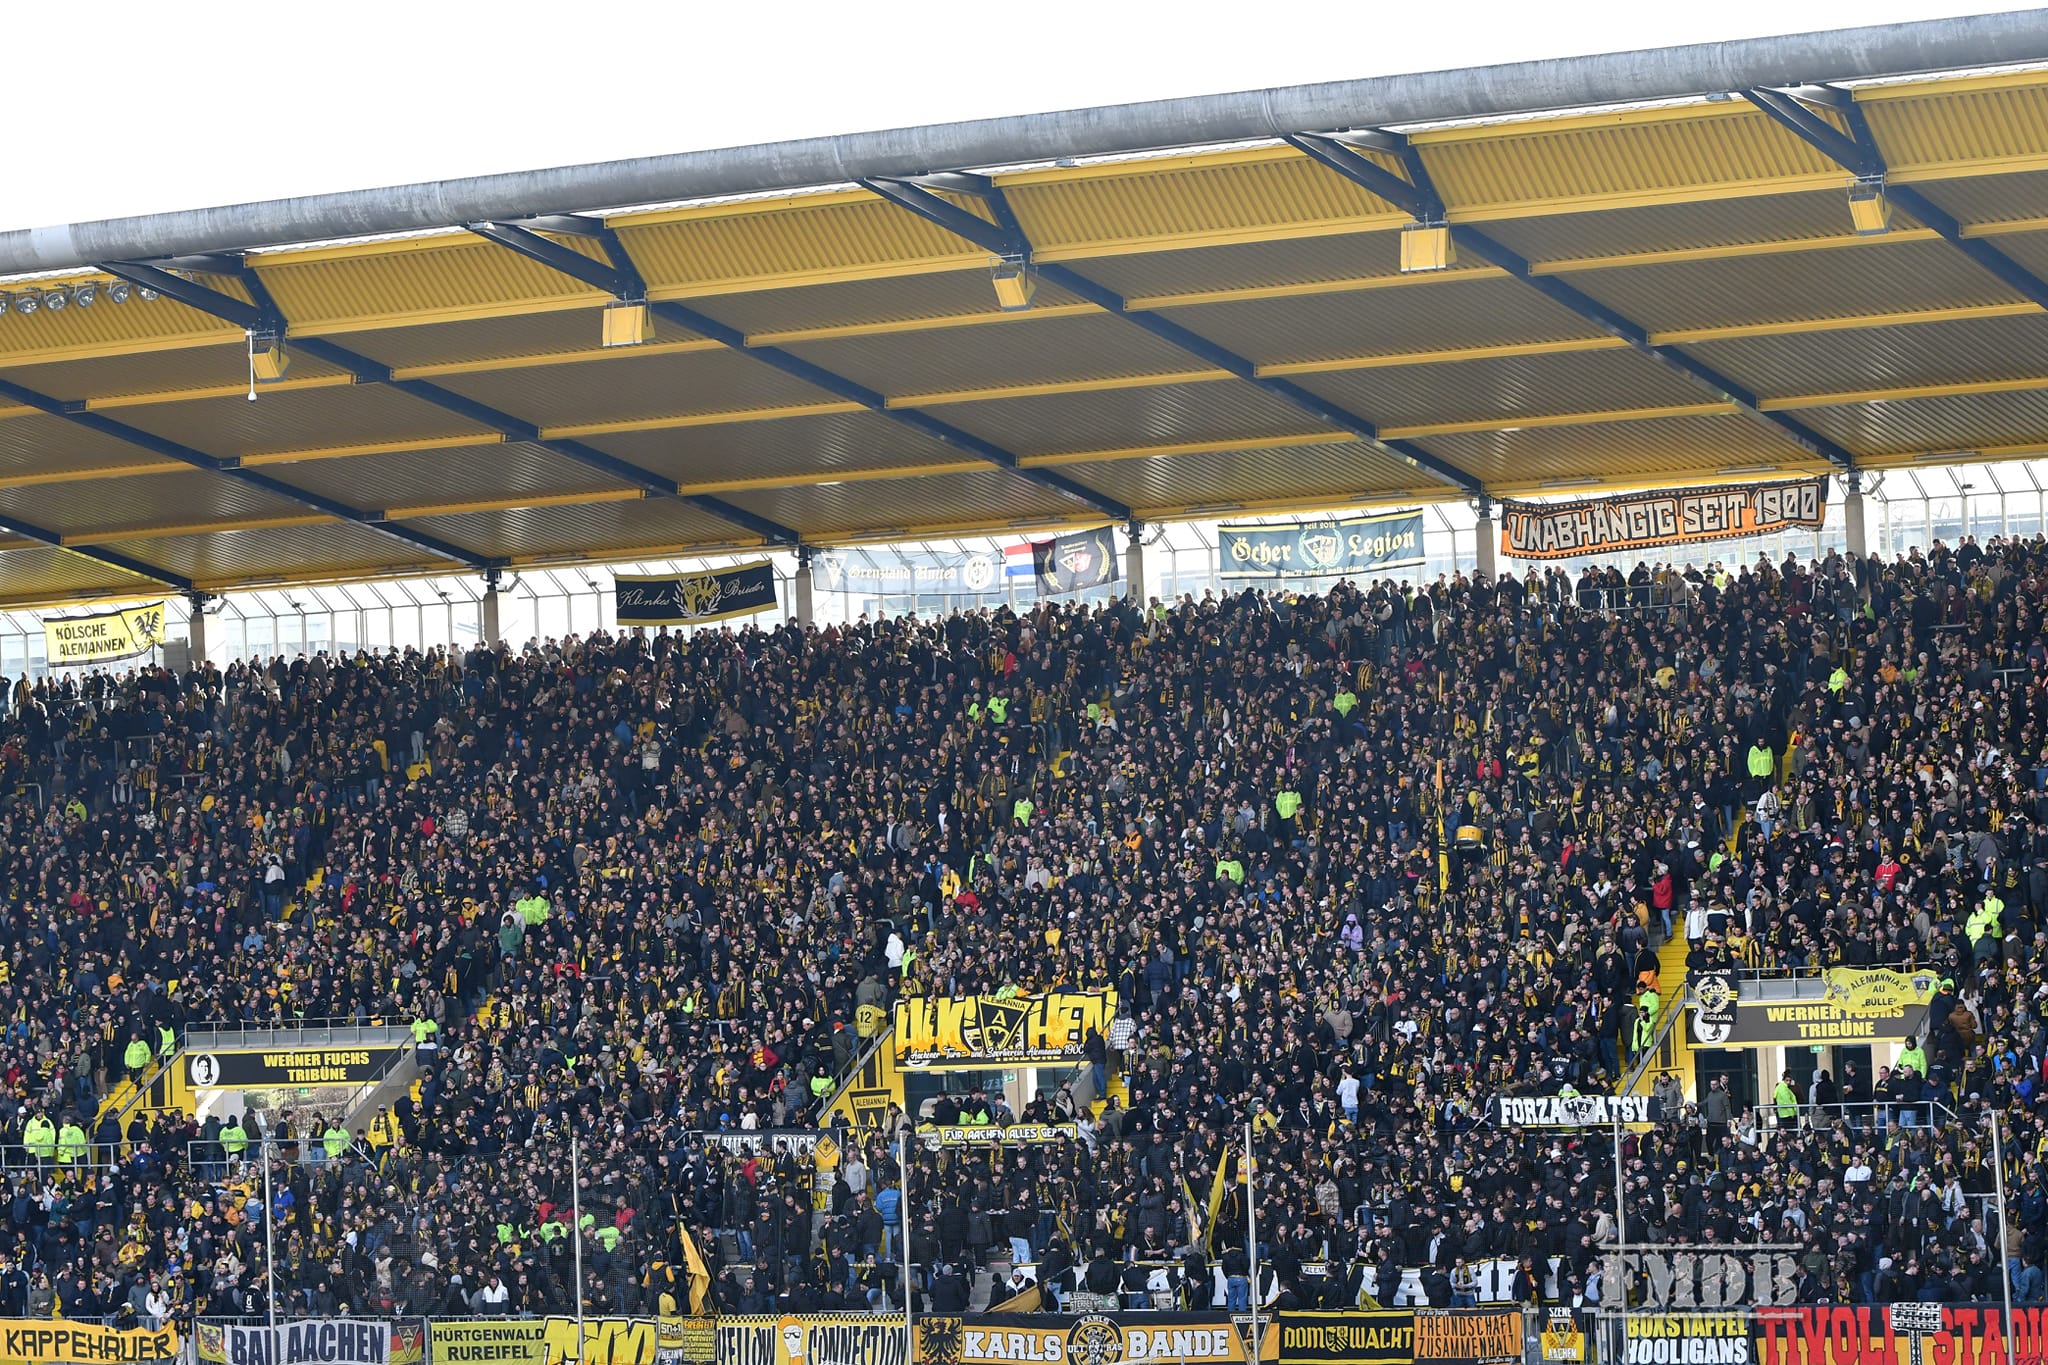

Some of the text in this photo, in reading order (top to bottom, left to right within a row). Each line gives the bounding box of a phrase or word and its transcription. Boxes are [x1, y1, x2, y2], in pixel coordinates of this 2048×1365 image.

[1509, 484, 1820, 552] UNABHÄNGIG SEIT 1900
[1231, 530, 1415, 565] Öcher Legion
[848, 563, 957, 581] Grenzland United
[56, 623, 107, 641] KÖLSCHE
[59, 637, 126, 657] ALEMANNEN
[1872, 985, 1886, 993] AU
[981, 995, 1026, 1010] ALEANNIA
[859, 1010, 872, 1024] 12
[1767, 1006, 1844, 1022] WERNER
[1798, 1020, 1875, 1038] TRIBÜNE
[264, 1051, 370, 1068] WERNER FUCHS
[288, 1066, 347, 1082] TRIBÜNE
[855, 1097, 887, 1107] ALEMANNIA
[1500, 1096, 1649, 1125] FORZA ATSV
[967, 1128, 1005, 1141] AACHEN
[1009, 1127, 1037, 1139] ALLES
[1420, 1314, 1513, 1337] FREUNDSCHAFT
[1627, 1311, 1748, 1337] BOXSTAFFEL
[6, 1325, 172, 1361] KAPPEHÄUER
[287, 1322, 385, 1364] AACHEN
[433, 1327, 545, 1343] HÜRTGENWALD
[717, 1325, 776, 1365] YELLOW
[808, 1325, 908, 1365] CONNECTION
[1284, 1325, 1414, 1350] DOM WACHT
[1756, 1306, 1899, 1365] TIVOLI
[447, 1345, 534, 1361] RUREIFEL
[963, 1330, 1229, 1361] KARLS BANDE
[1418, 1334, 1514, 1358] ZUSAMMENHALT
[1624, 1337, 1748, 1365] HOOLIGANS
